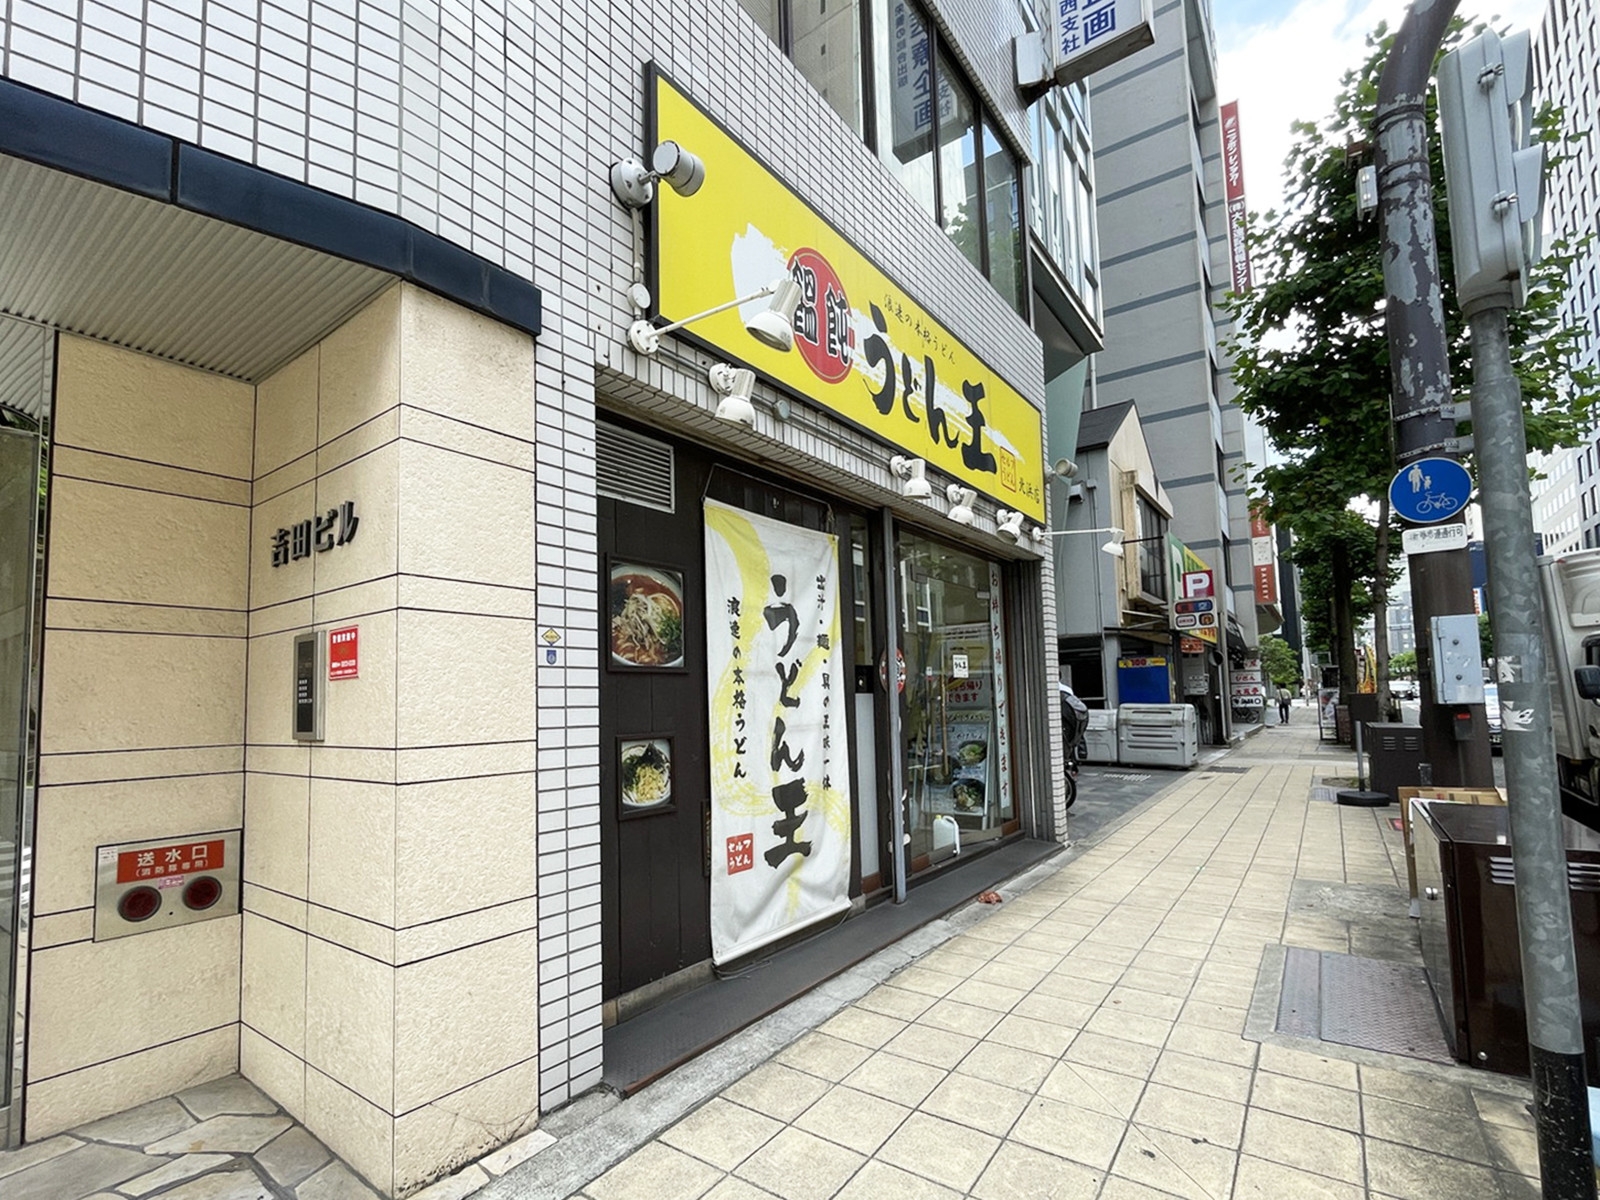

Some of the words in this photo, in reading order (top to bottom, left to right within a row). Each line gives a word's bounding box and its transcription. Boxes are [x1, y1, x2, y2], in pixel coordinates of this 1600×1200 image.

[1059, 0, 1081, 55] 西支社
[863, 301, 997, 475] うどん王
[270, 501, 359, 568] 吉田ビル
[1186, 572, 1210, 598] P
[1260, 567, 1270, 600] BAKERY
[727, 597, 747, 779] 浪速の本格うどん
[763, 574, 812, 869] うどん王
[138, 845, 208, 867] 送水口
[728, 838, 752, 855] セルフ
[728, 853, 752, 870] うどん
